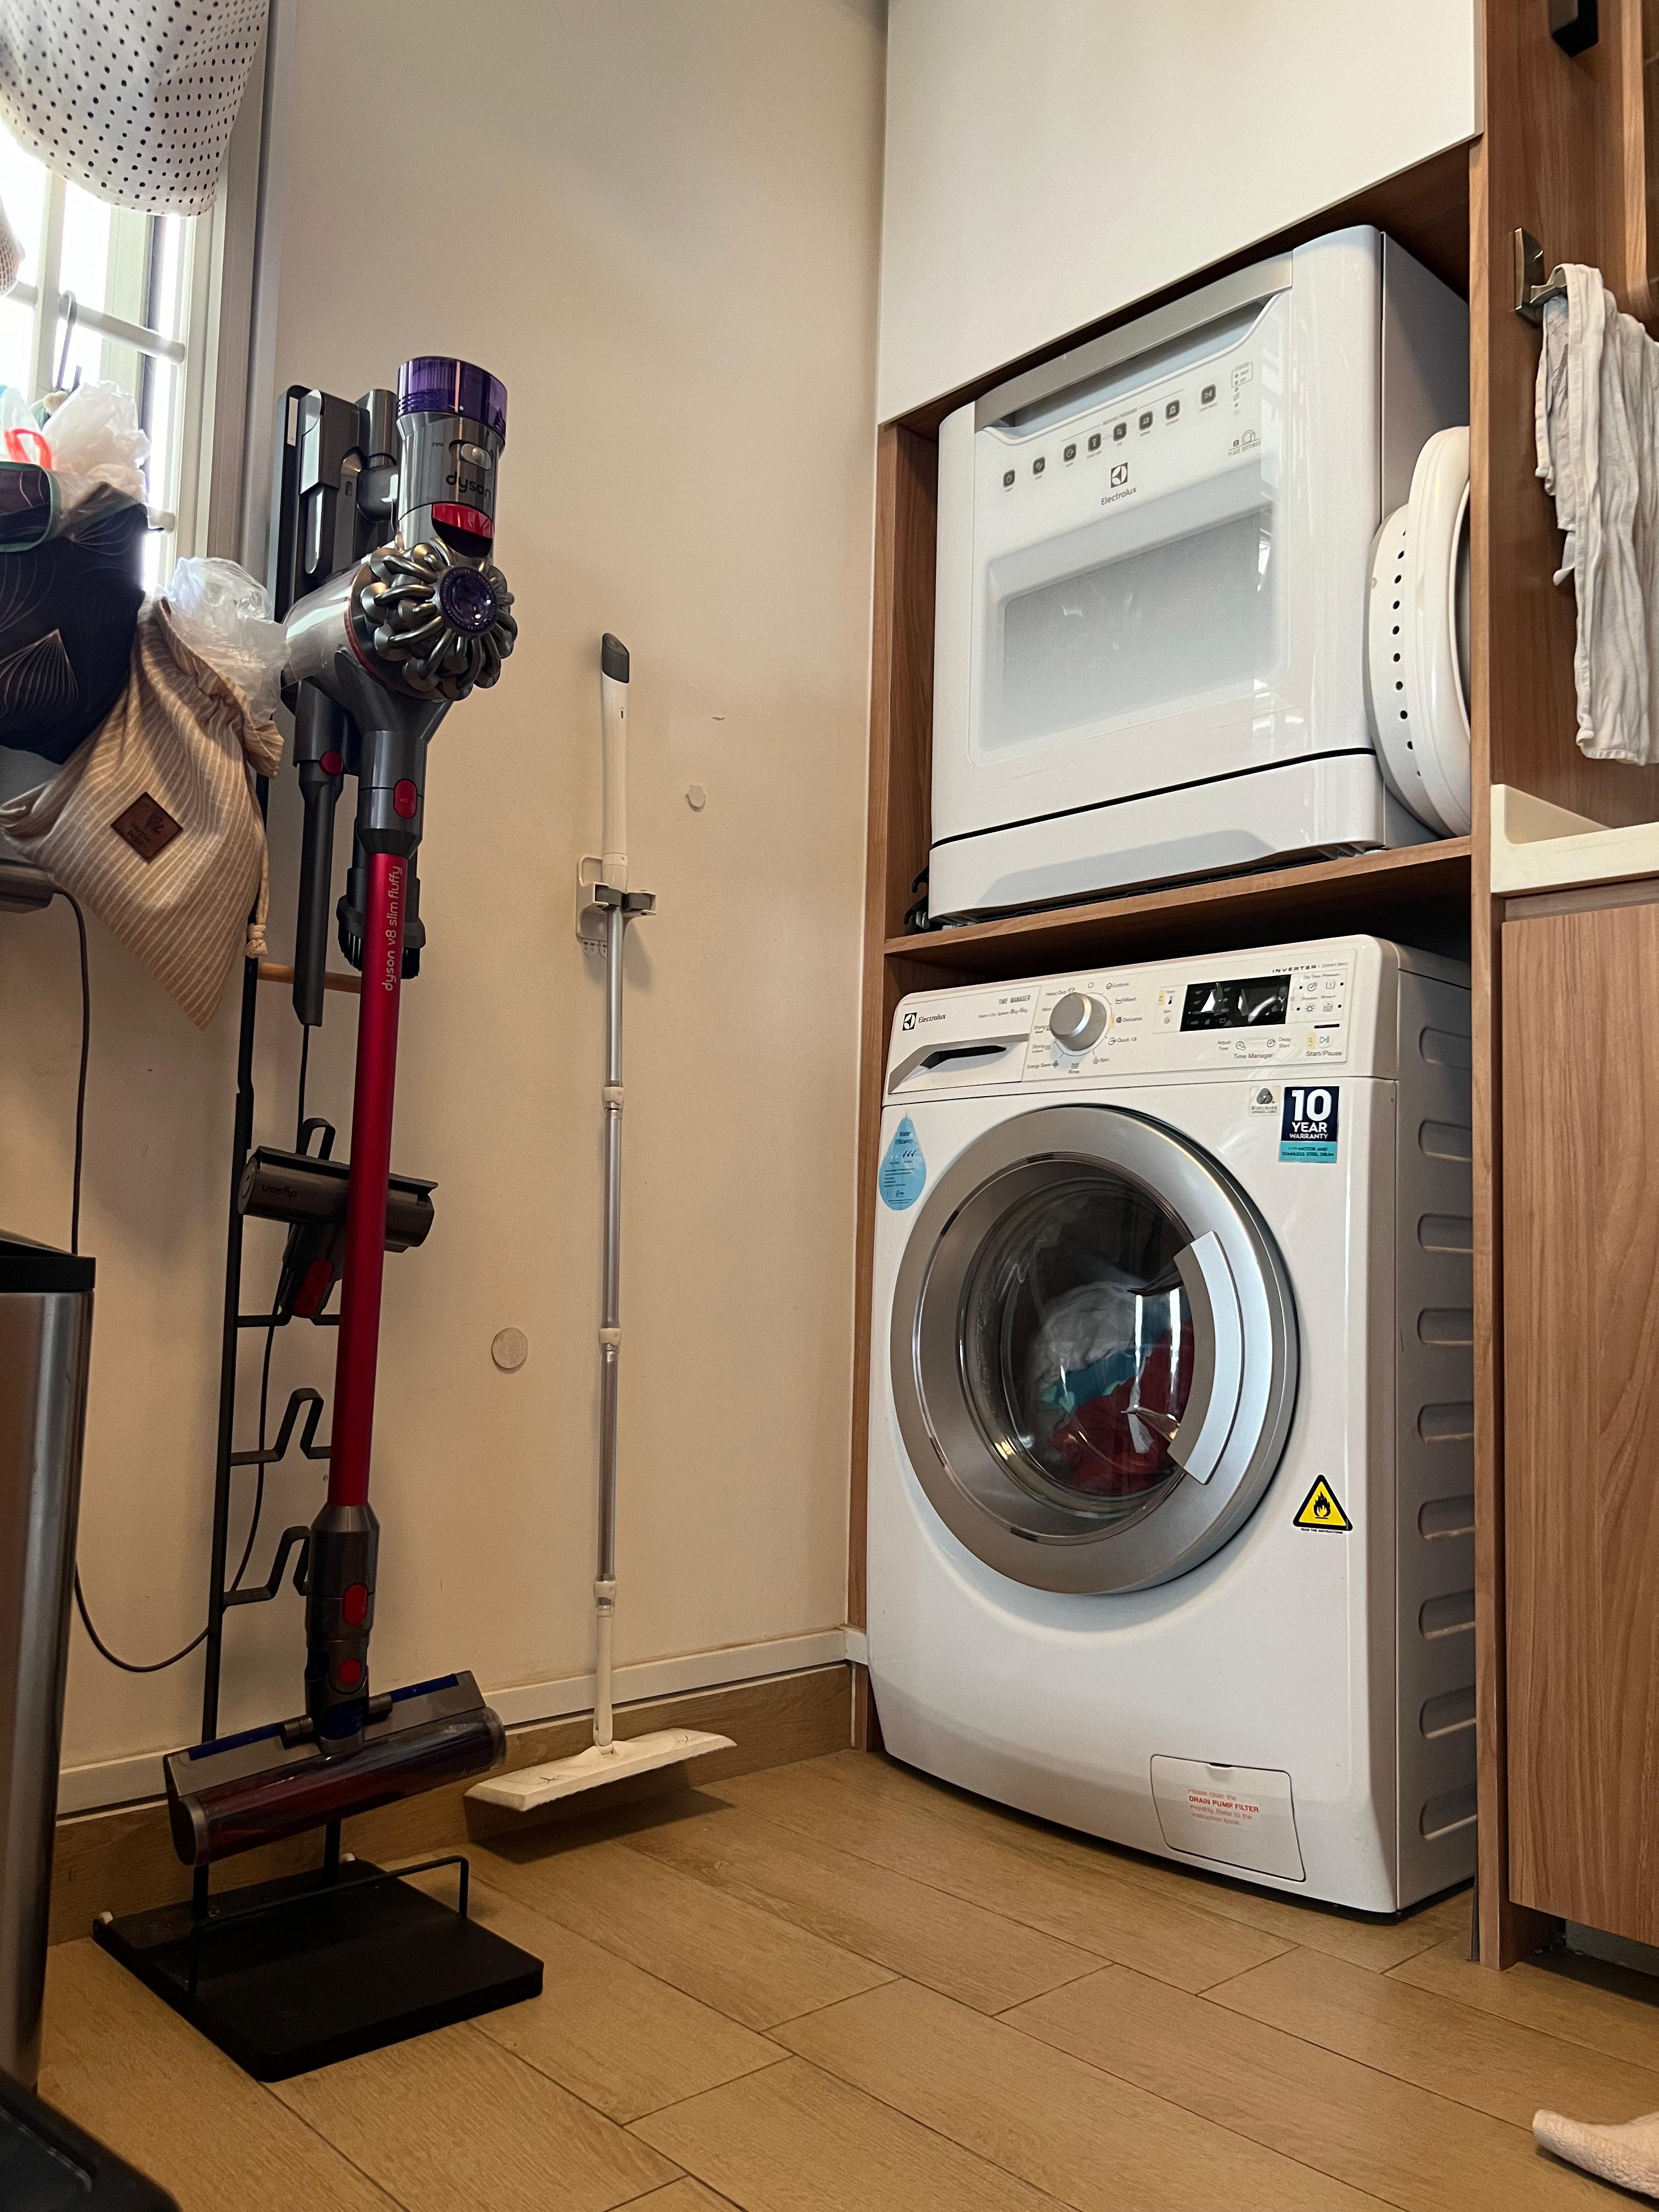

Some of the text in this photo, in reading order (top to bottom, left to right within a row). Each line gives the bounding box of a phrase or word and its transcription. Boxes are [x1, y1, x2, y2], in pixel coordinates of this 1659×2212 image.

[445, 470, 491, 501] dyson
[1101, 487, 1137, 505] Electrolux
[382, 866, 403, 991] dyson v8 slim fluffy
[1272, 964, 1317, 973] INVERTER
[1009, 995, 1031, 1003] MANAGER
[918, 1013, 946, 1023] Electrolux
[1291, 1088, 1332, 1121] 10
[1291, 1122, 1328, 1132] YEAR
[262, 1185, 297, 1199] dyson
[1189, 1795, 1259, 1813] DRAIN PUMP FILTER
